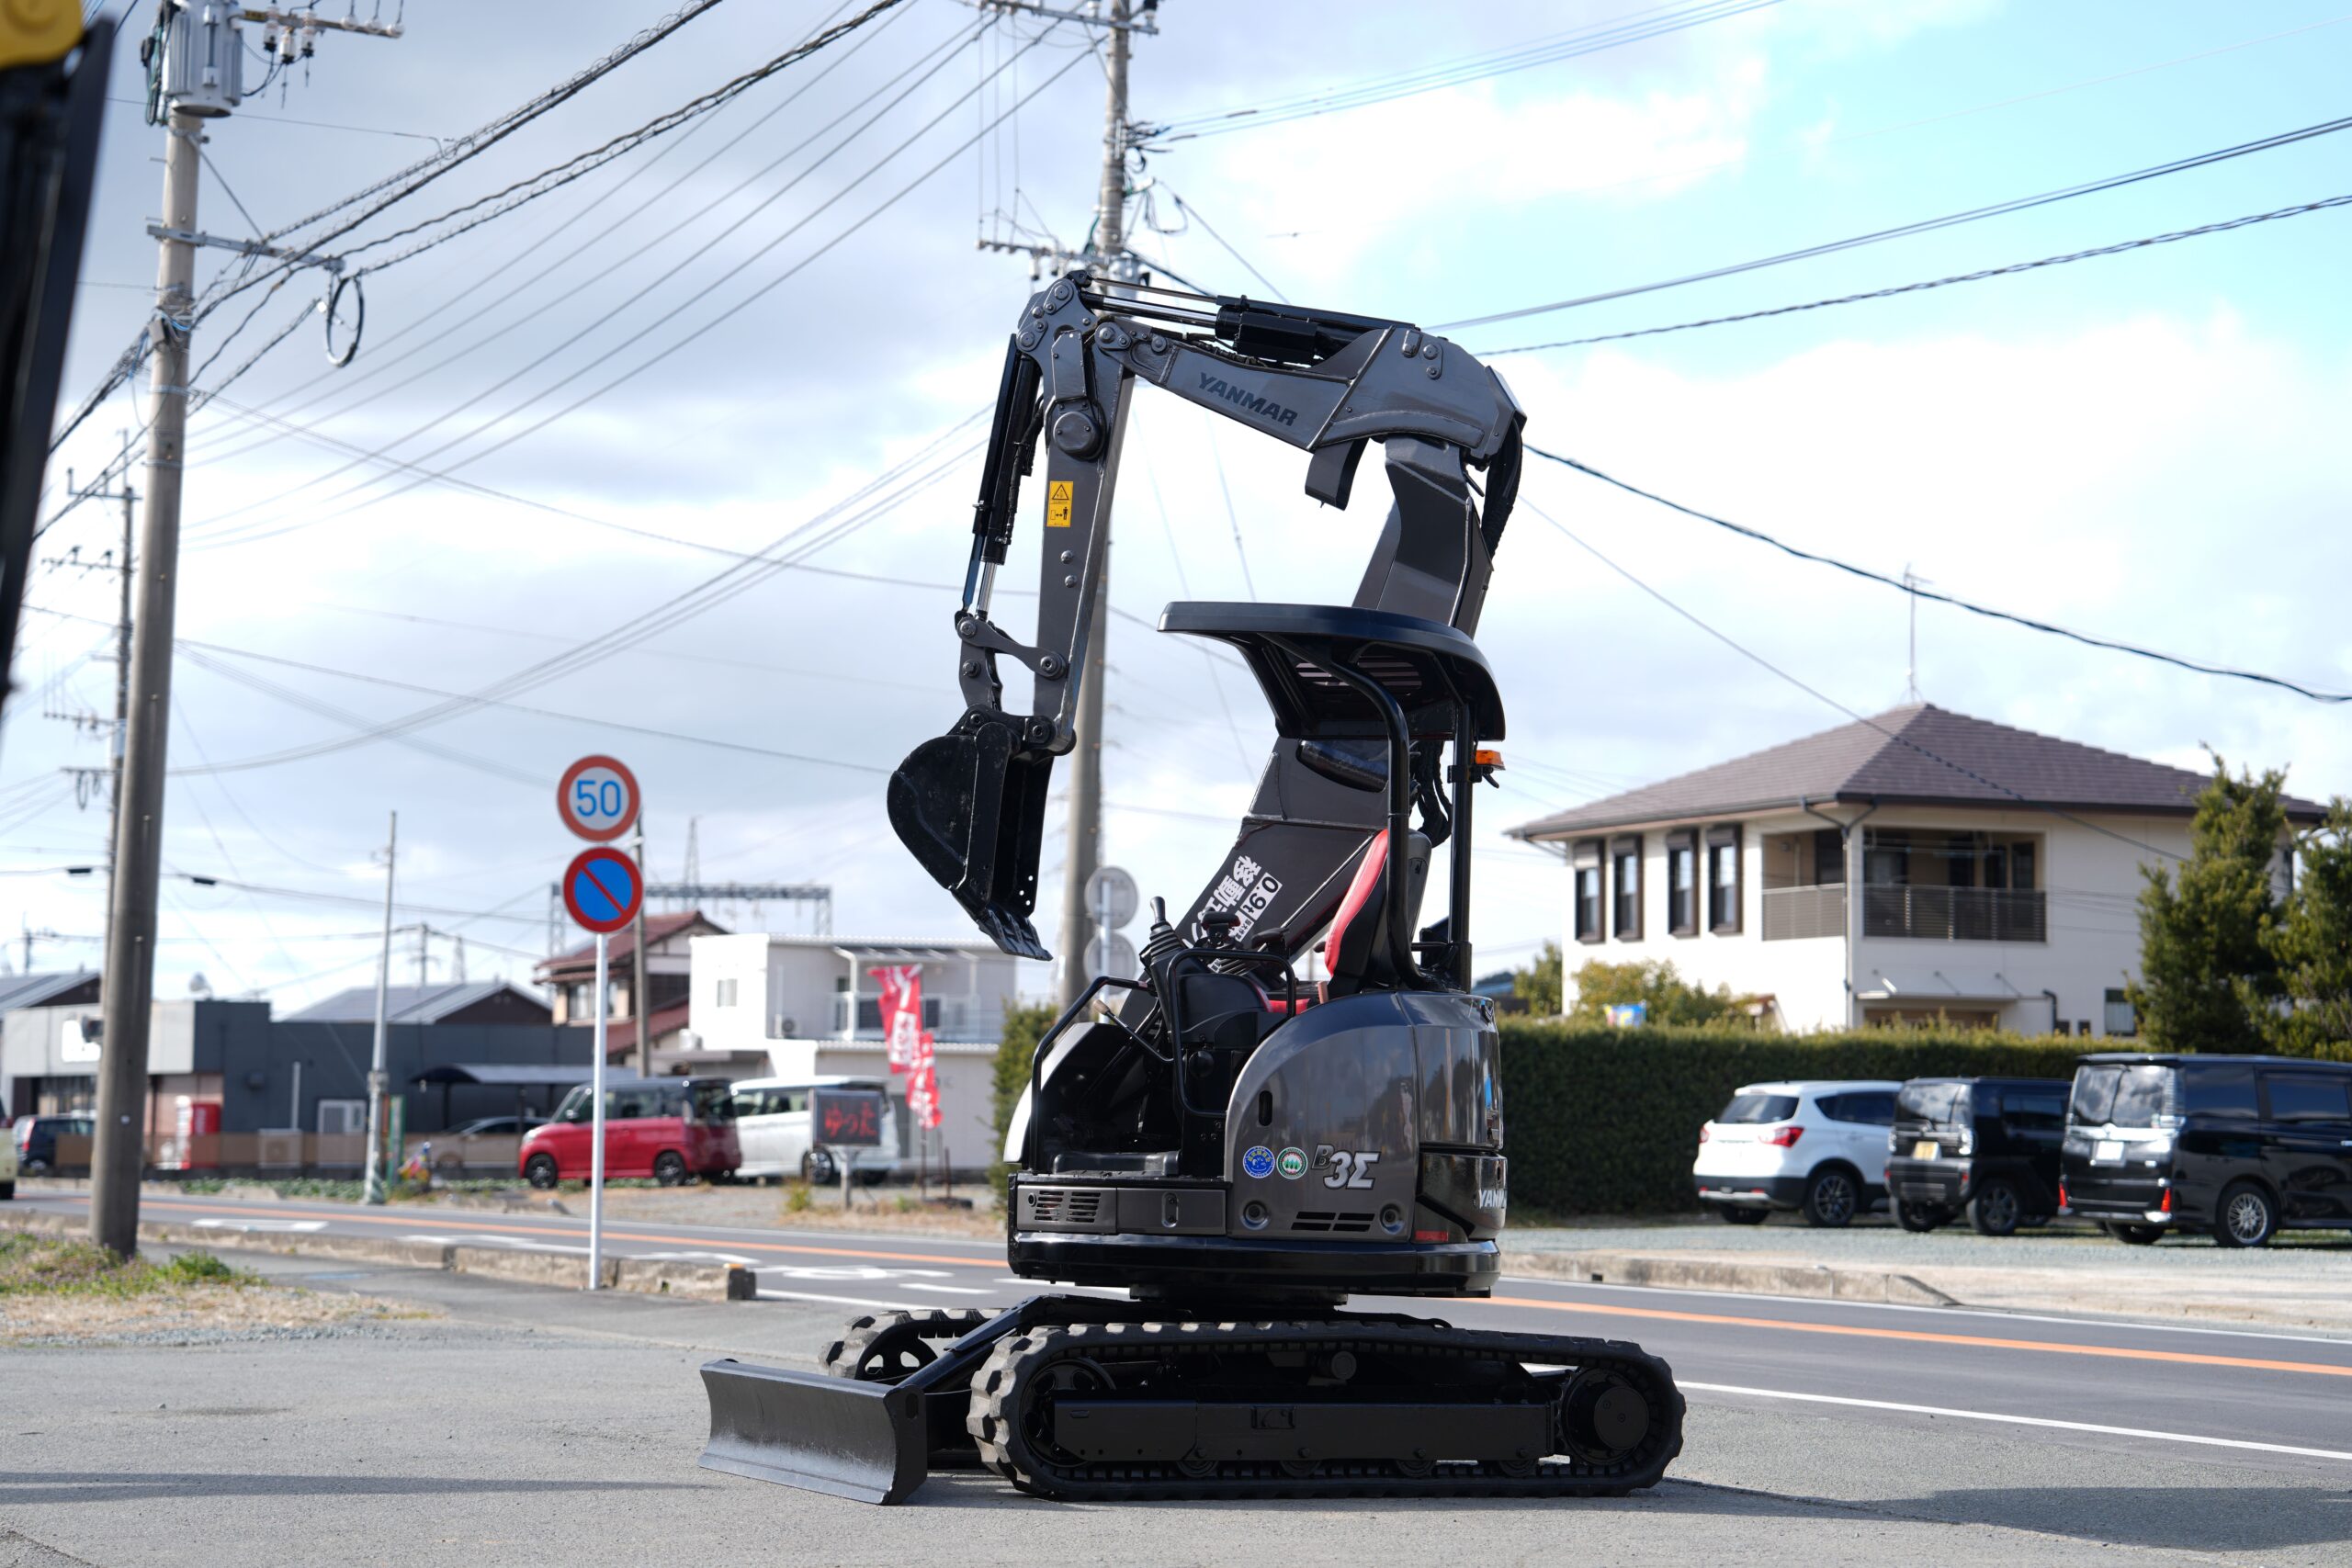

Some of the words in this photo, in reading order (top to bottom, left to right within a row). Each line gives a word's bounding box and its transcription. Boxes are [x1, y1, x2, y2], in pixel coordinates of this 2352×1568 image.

[1198, 372, 1298, 426] YANMAR
[576, 780, 621, 817] 50
[1243, 876, 1279, 913] 0.9t
